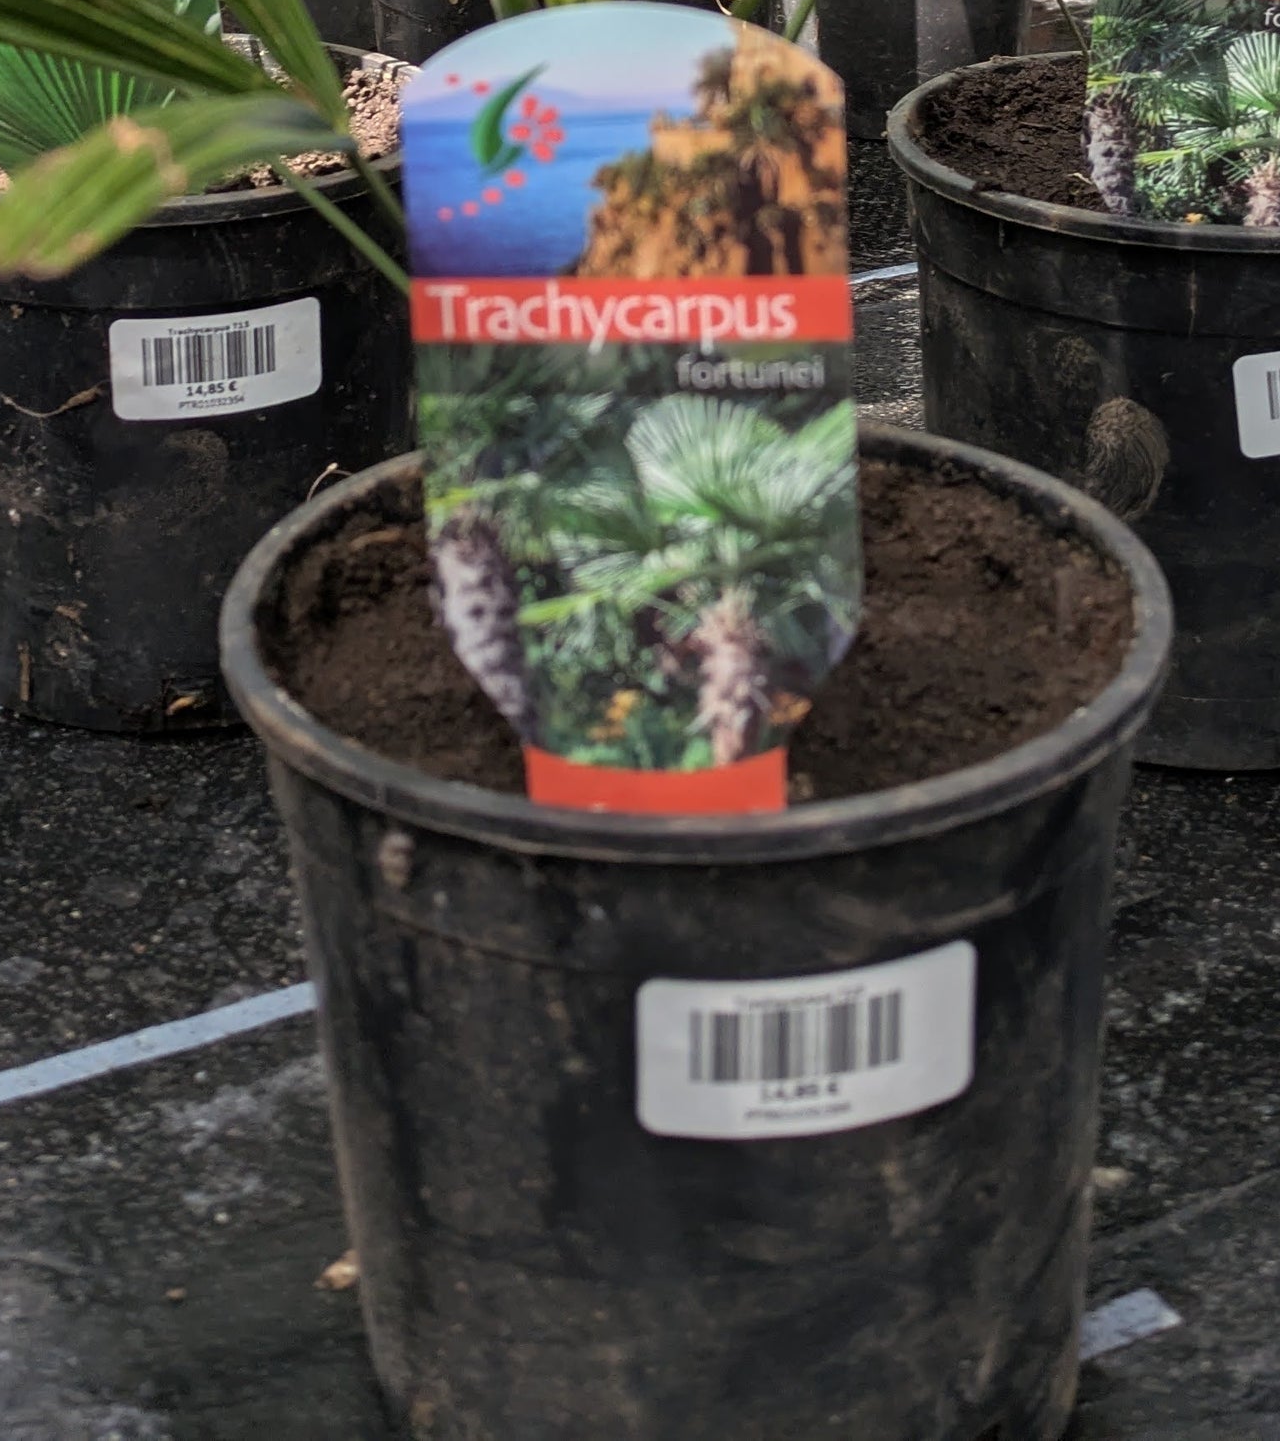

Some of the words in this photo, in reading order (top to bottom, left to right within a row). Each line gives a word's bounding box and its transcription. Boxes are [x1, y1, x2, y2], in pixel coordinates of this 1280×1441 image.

[425, 280, 798, 355] Trachycarpus
[186, 383, 225, 398] 14,85
[228, 381, 239, 392] €
[677, 356, 826, 390] fortunei
